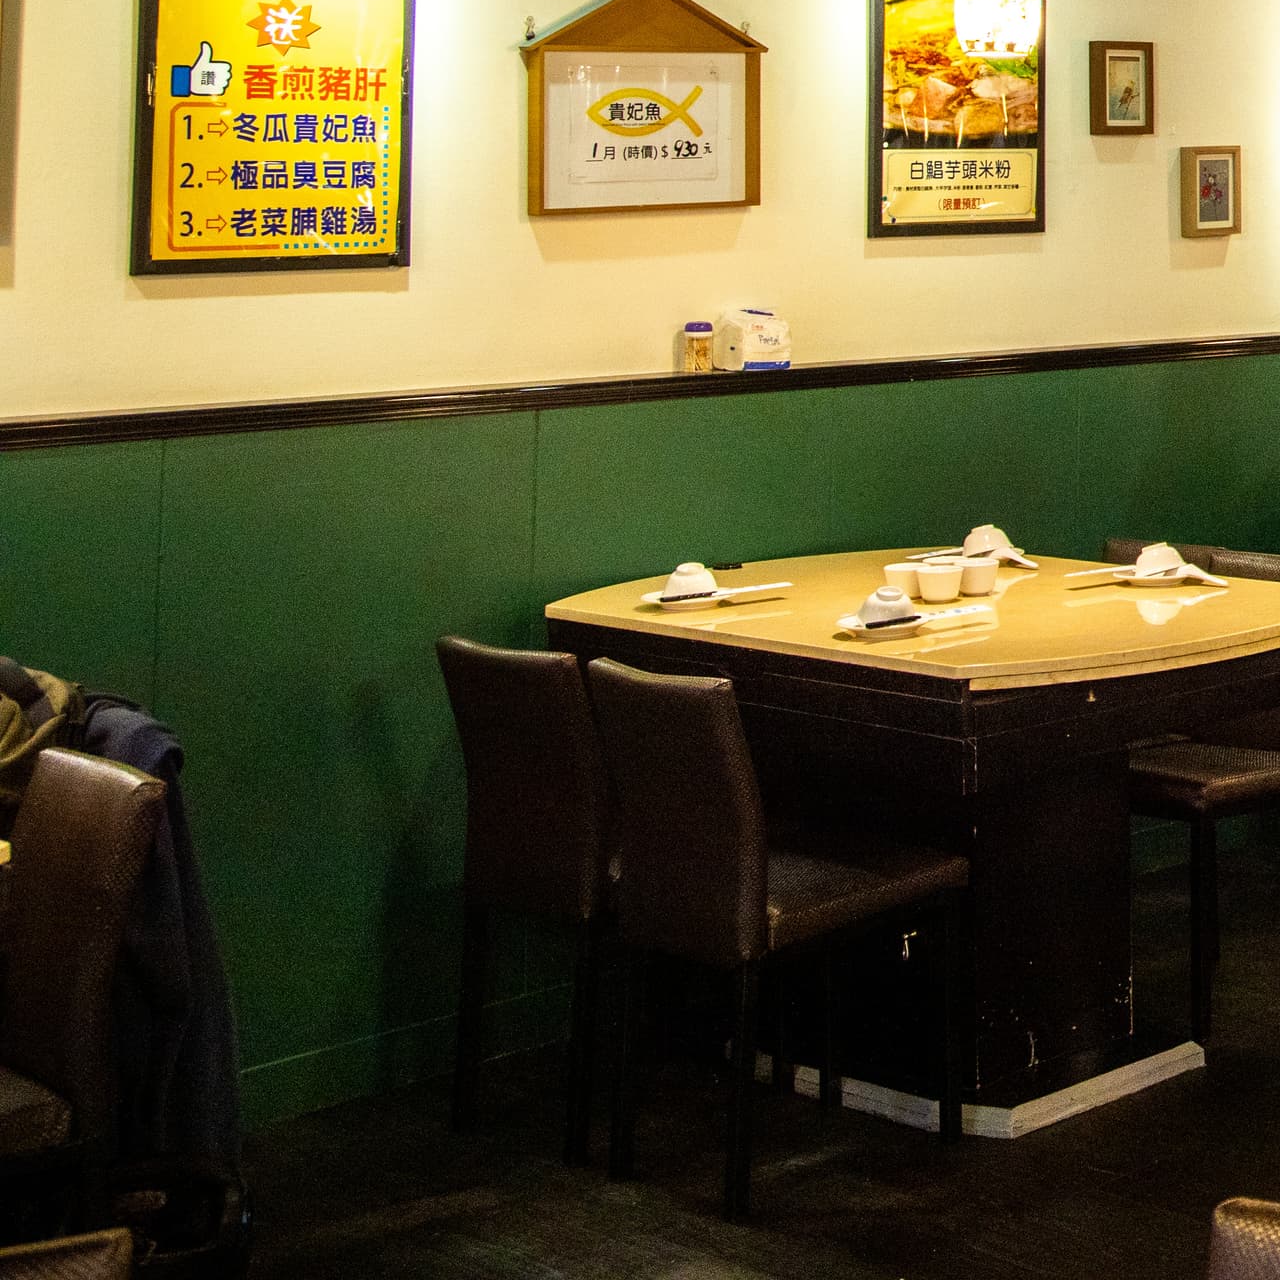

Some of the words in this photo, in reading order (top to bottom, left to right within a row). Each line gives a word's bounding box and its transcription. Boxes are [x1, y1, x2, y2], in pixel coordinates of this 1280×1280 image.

[264, 7, 304, 45] 送
[243, 64, 387, 101] 香煎豬肝
[232, 112, 377, 144] 冬瓜貴妃魚
[608, 102, 662, 122] 貴妃魚
[230, 159, 376, 191] 極品臭豆腐
[910, 159, 1011, 181] 白鯧芋頭米粉
[230, 206, 377, 238] 老菜脯雞湯
